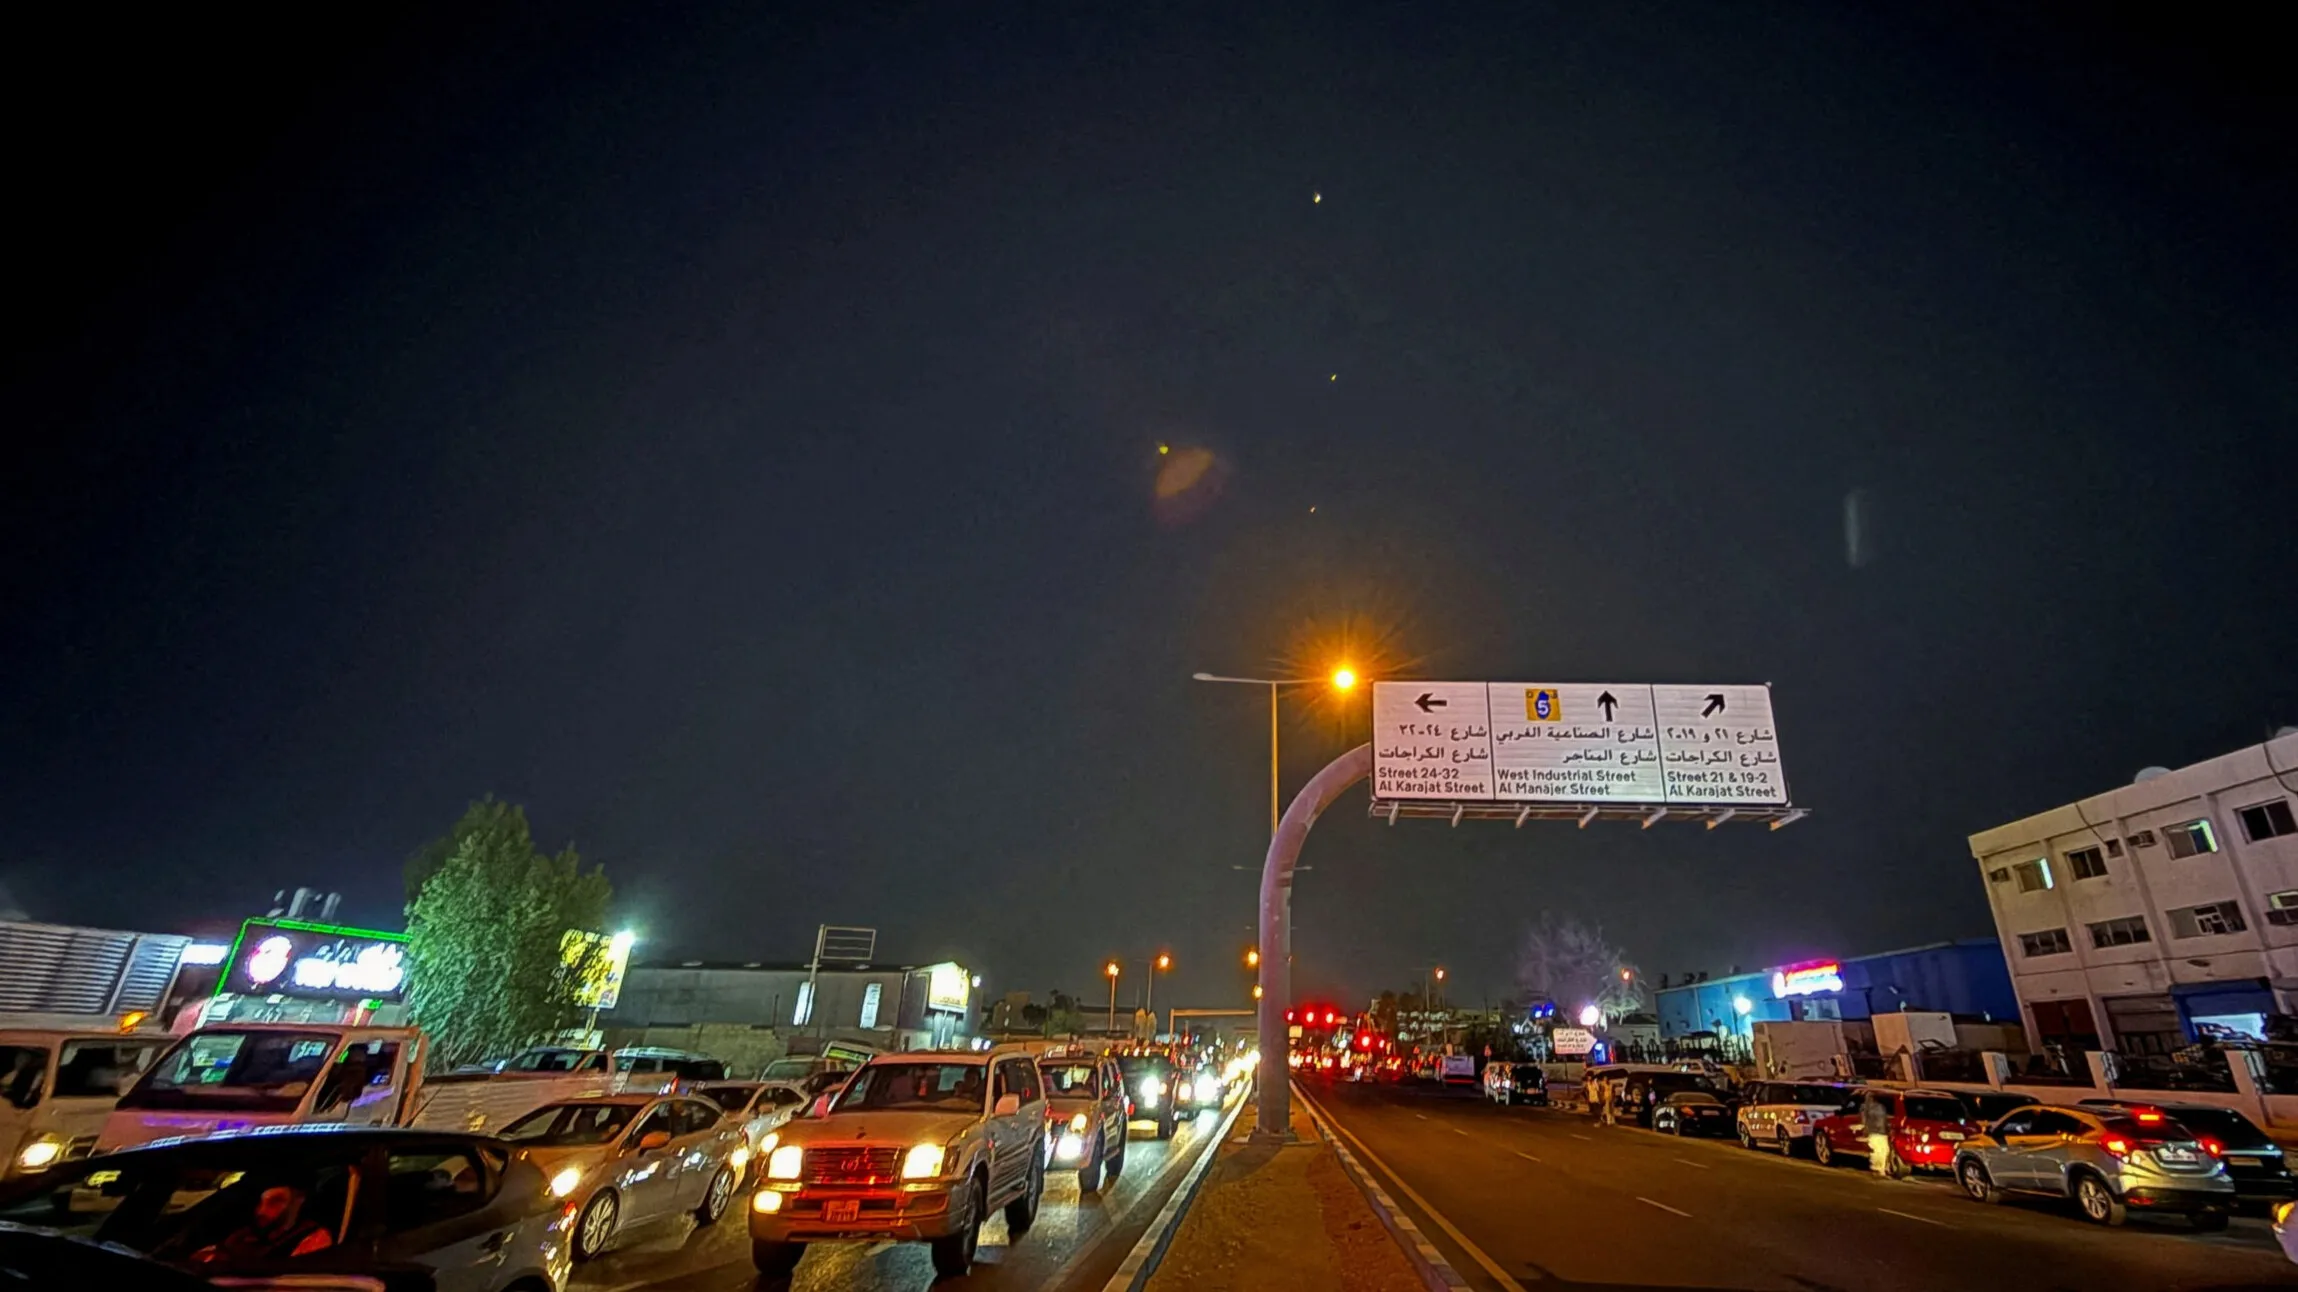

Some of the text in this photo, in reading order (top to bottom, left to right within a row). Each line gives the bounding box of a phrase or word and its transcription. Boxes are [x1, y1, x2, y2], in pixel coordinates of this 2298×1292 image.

[1537, 699, 1549, 716] 5
[1451, 725, 1487, 741] شارع
[1496, 726, 1654, 745] شارع الصناعية الغربي
[1702, 733, 1710, 743] و
[1736, 729, 1773, 745] شارع
[1379, 746, 1488, 764] شارع الكراجات
[1619, 748, 1657, 767] شارع
[1665, 749, 1777, 767] شارع الكراجات
[1379, 767, 1459, 780] Street 24-32
[1497, 769, 1636, 782] West Industrial Street
[1667, 769, 1768, 783] Street 21 & 19-2
[1379, 780, 1485, 794] Al Karajat Street
[1499, 782, 1611, 796] Al Manajer Street
[1669, 784, 1777, 798] Al Karajat Street
